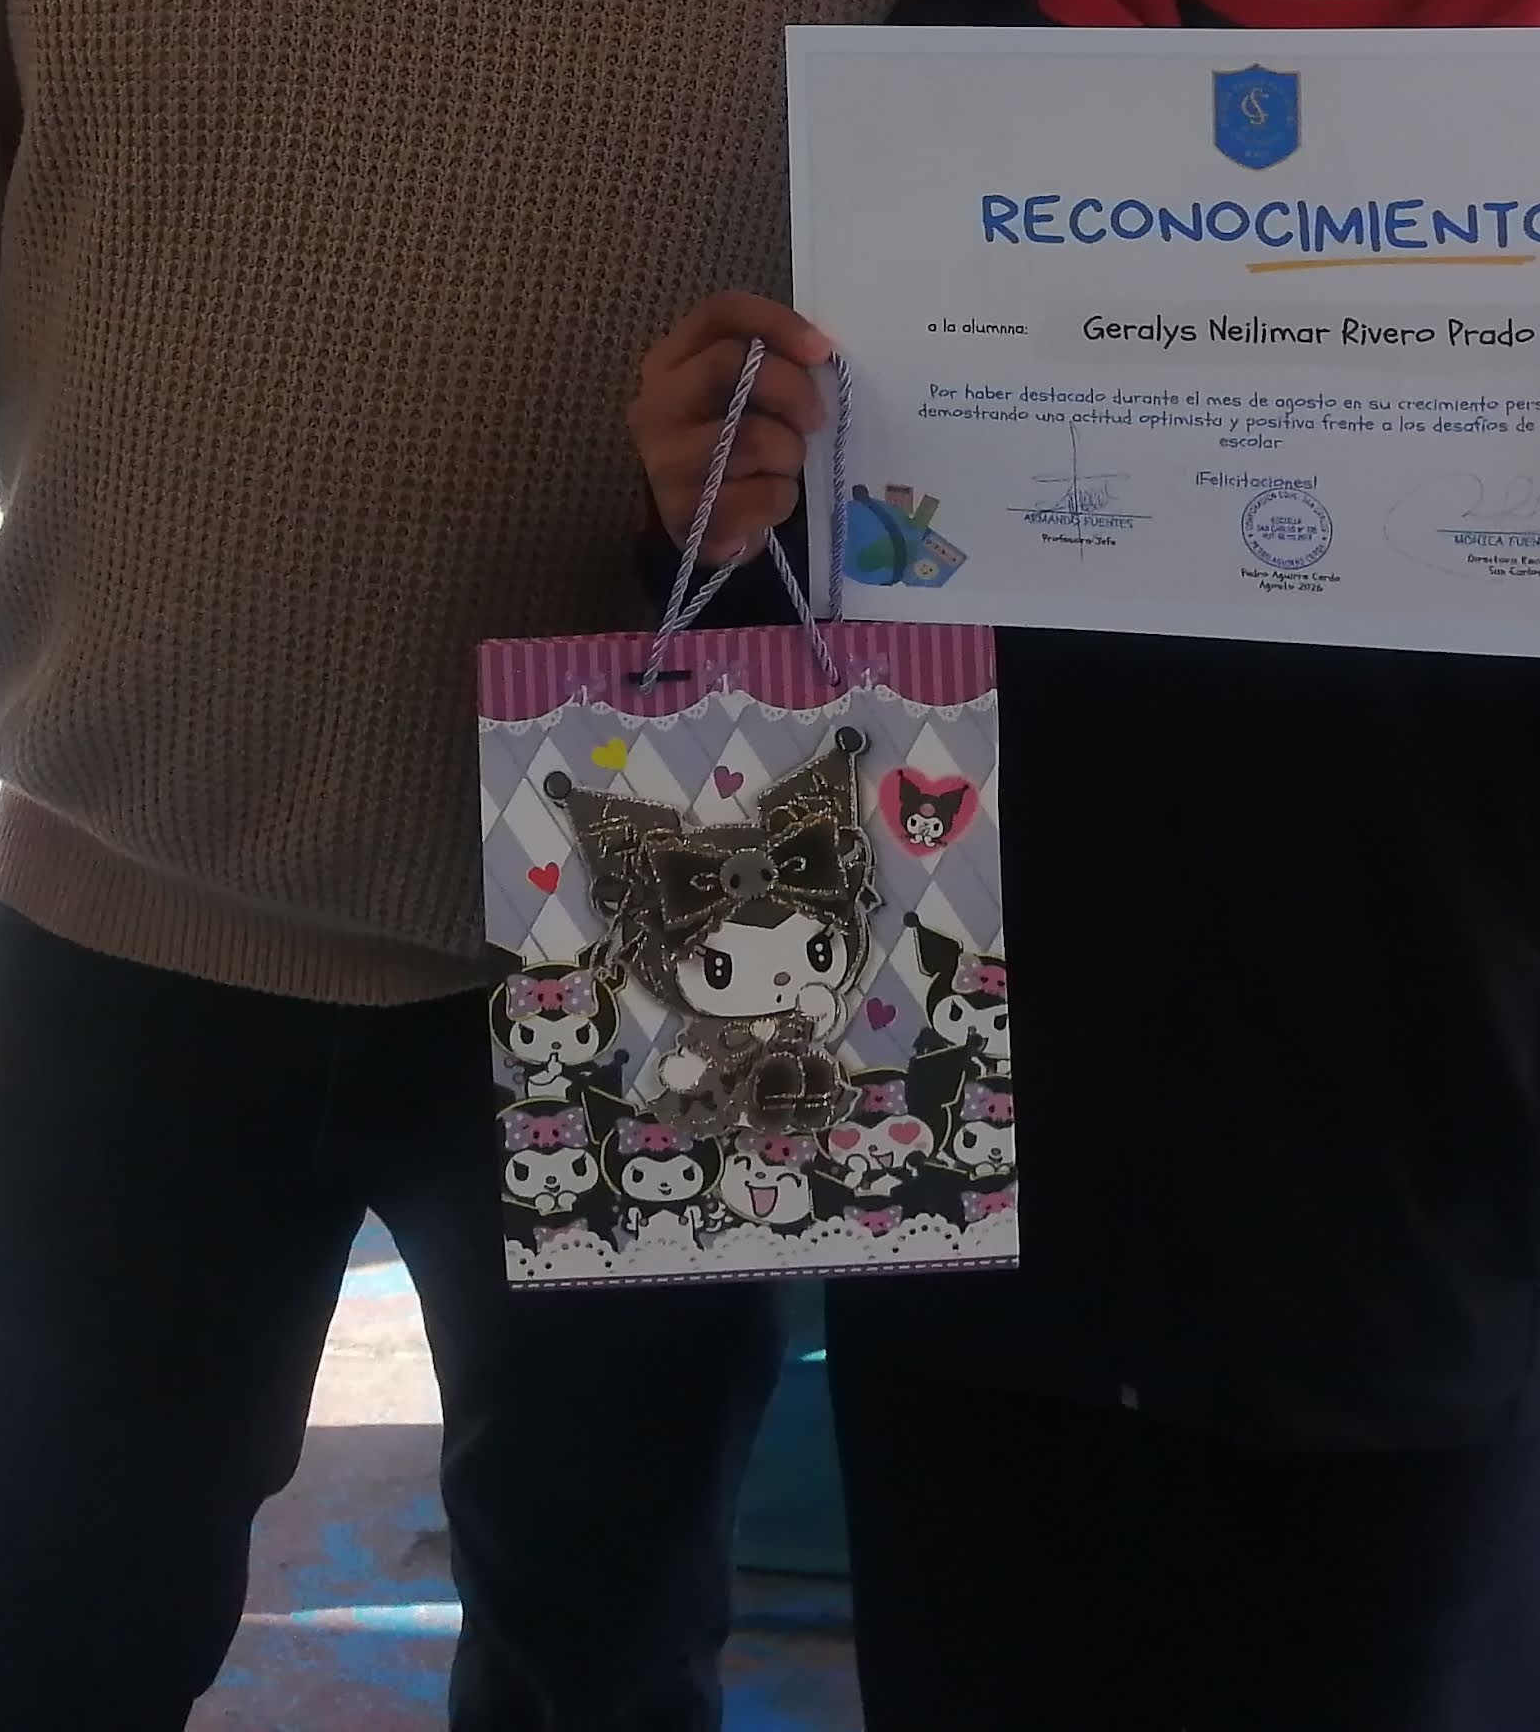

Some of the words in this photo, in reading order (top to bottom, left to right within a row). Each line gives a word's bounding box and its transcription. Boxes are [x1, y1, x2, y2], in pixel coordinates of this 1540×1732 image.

[927, 322, 938, 334] a
[942, 318, 956, 334] la
[1082, 314, 1198, 350] Geralys
[1209, 314, 1331, 345] Neilimar
[1341, 317, 1436, 346] Rivero
[1448, 318, 1536, 347] Prado
[928, 383, 959, 400] Por
[965, 384, 1012, 401] haber
[1018, 386, 1106, 404] destacado
[1112, 388, 1180, 406] durante
[1186, 391, 1200, 406] el
[1206, 395, 1242, 408] mes
[1248, 391, 1269, 409] de
[1275, 392, 1337, 419] agosto
[1343, 397, 1363, 410] en
[1368, 398, 1391, 411] su
[1397, 395, 1499, 413] crecimiento
[918, 403, 1029, 422] demostrando
[1036, 410, 1065, 423] una
[1072, 408, 1133, 426] actitud
[1138, 409, 1223, 430] optimista
[1229, 417, 1239, 432] y
[1246, 414, 1315, 432] positiva
[1322, 416, 1375, 433] frente
[1381, 420, 1394, 432] a
[1400, 416, 1426, 433] los
[1432, 416, 1508, 434] desafíos
[1515, 416, 1535, 433] de
[1218, 433, 1283, 450] escolar
[1196, 470, 1318, 490] ¡Felicitaciones!
[1083, 516, 1134, 529] FUENTES
[1241, 567, 1270, 578] Pedro
[1271, 570, 1309, 583] Aguirre
